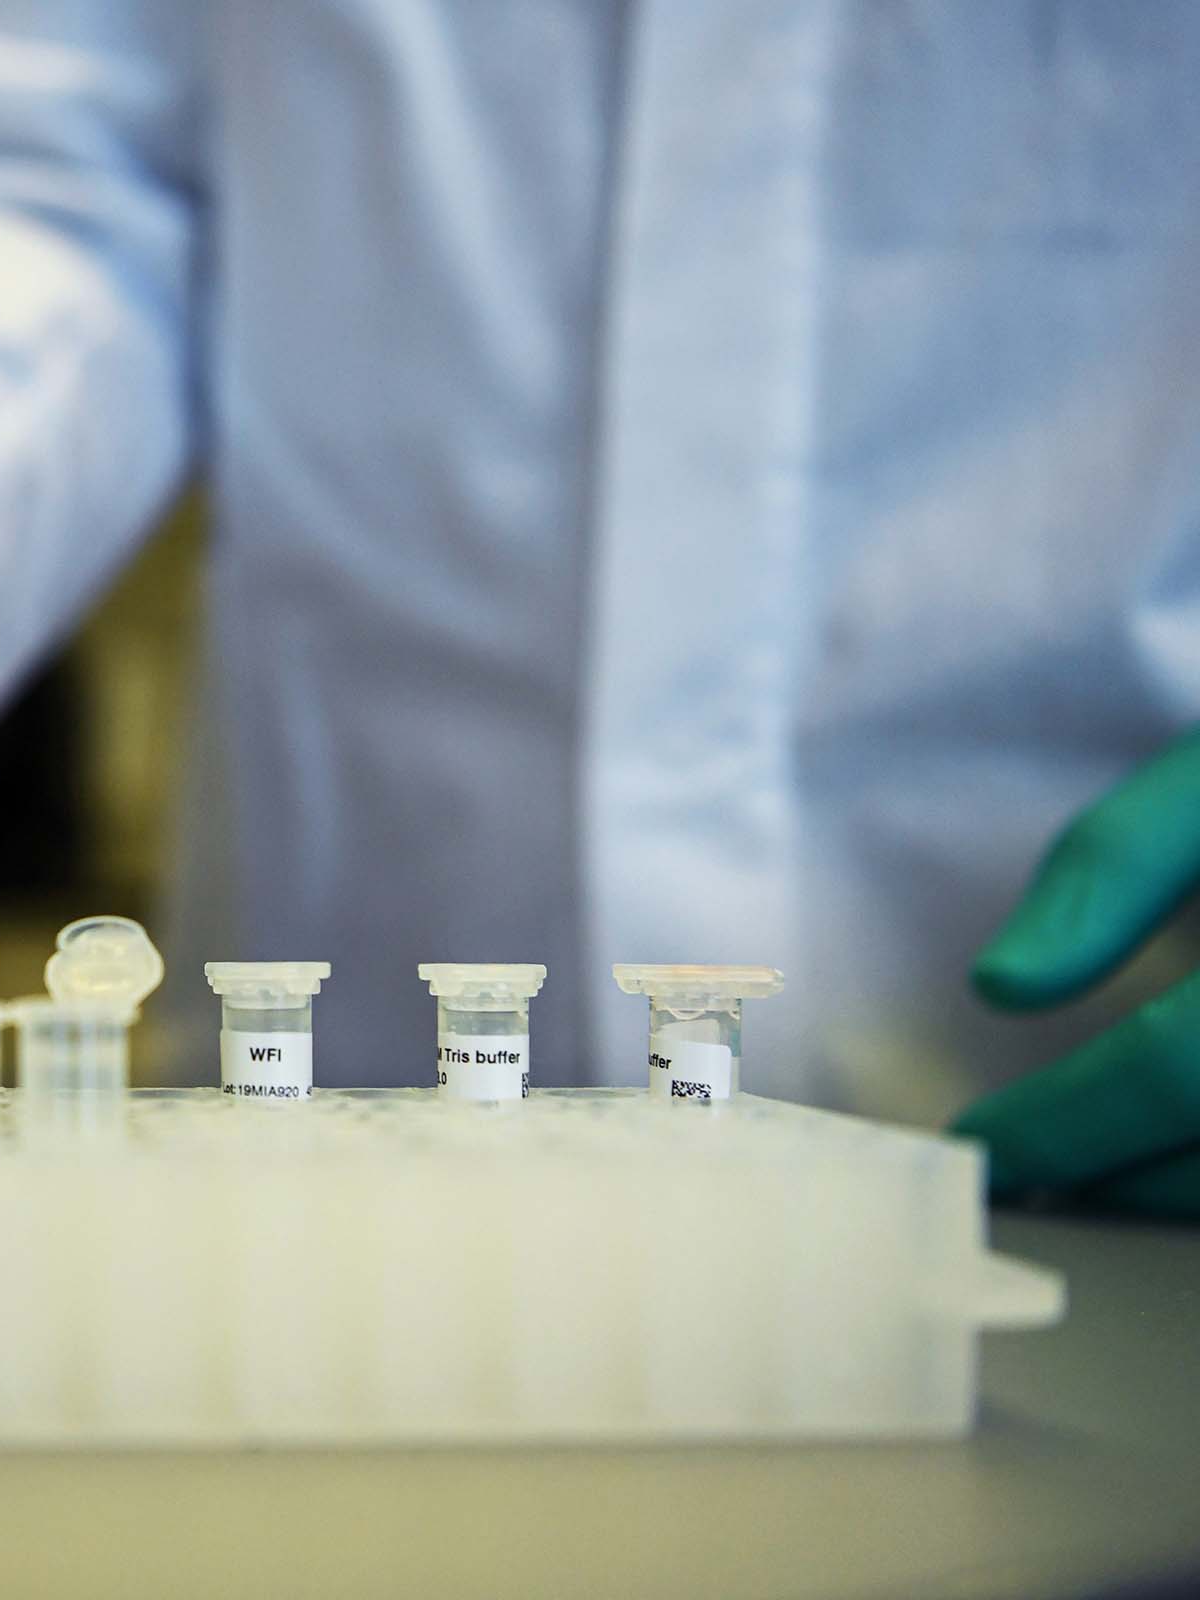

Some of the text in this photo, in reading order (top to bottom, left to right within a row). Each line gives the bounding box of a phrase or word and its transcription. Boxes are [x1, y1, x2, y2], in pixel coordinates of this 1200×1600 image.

[249, 1047, 282, 1062] WFI
[445, 1048, 470, 1063] Tris
[476, 1050, 520, 1064] buffer
